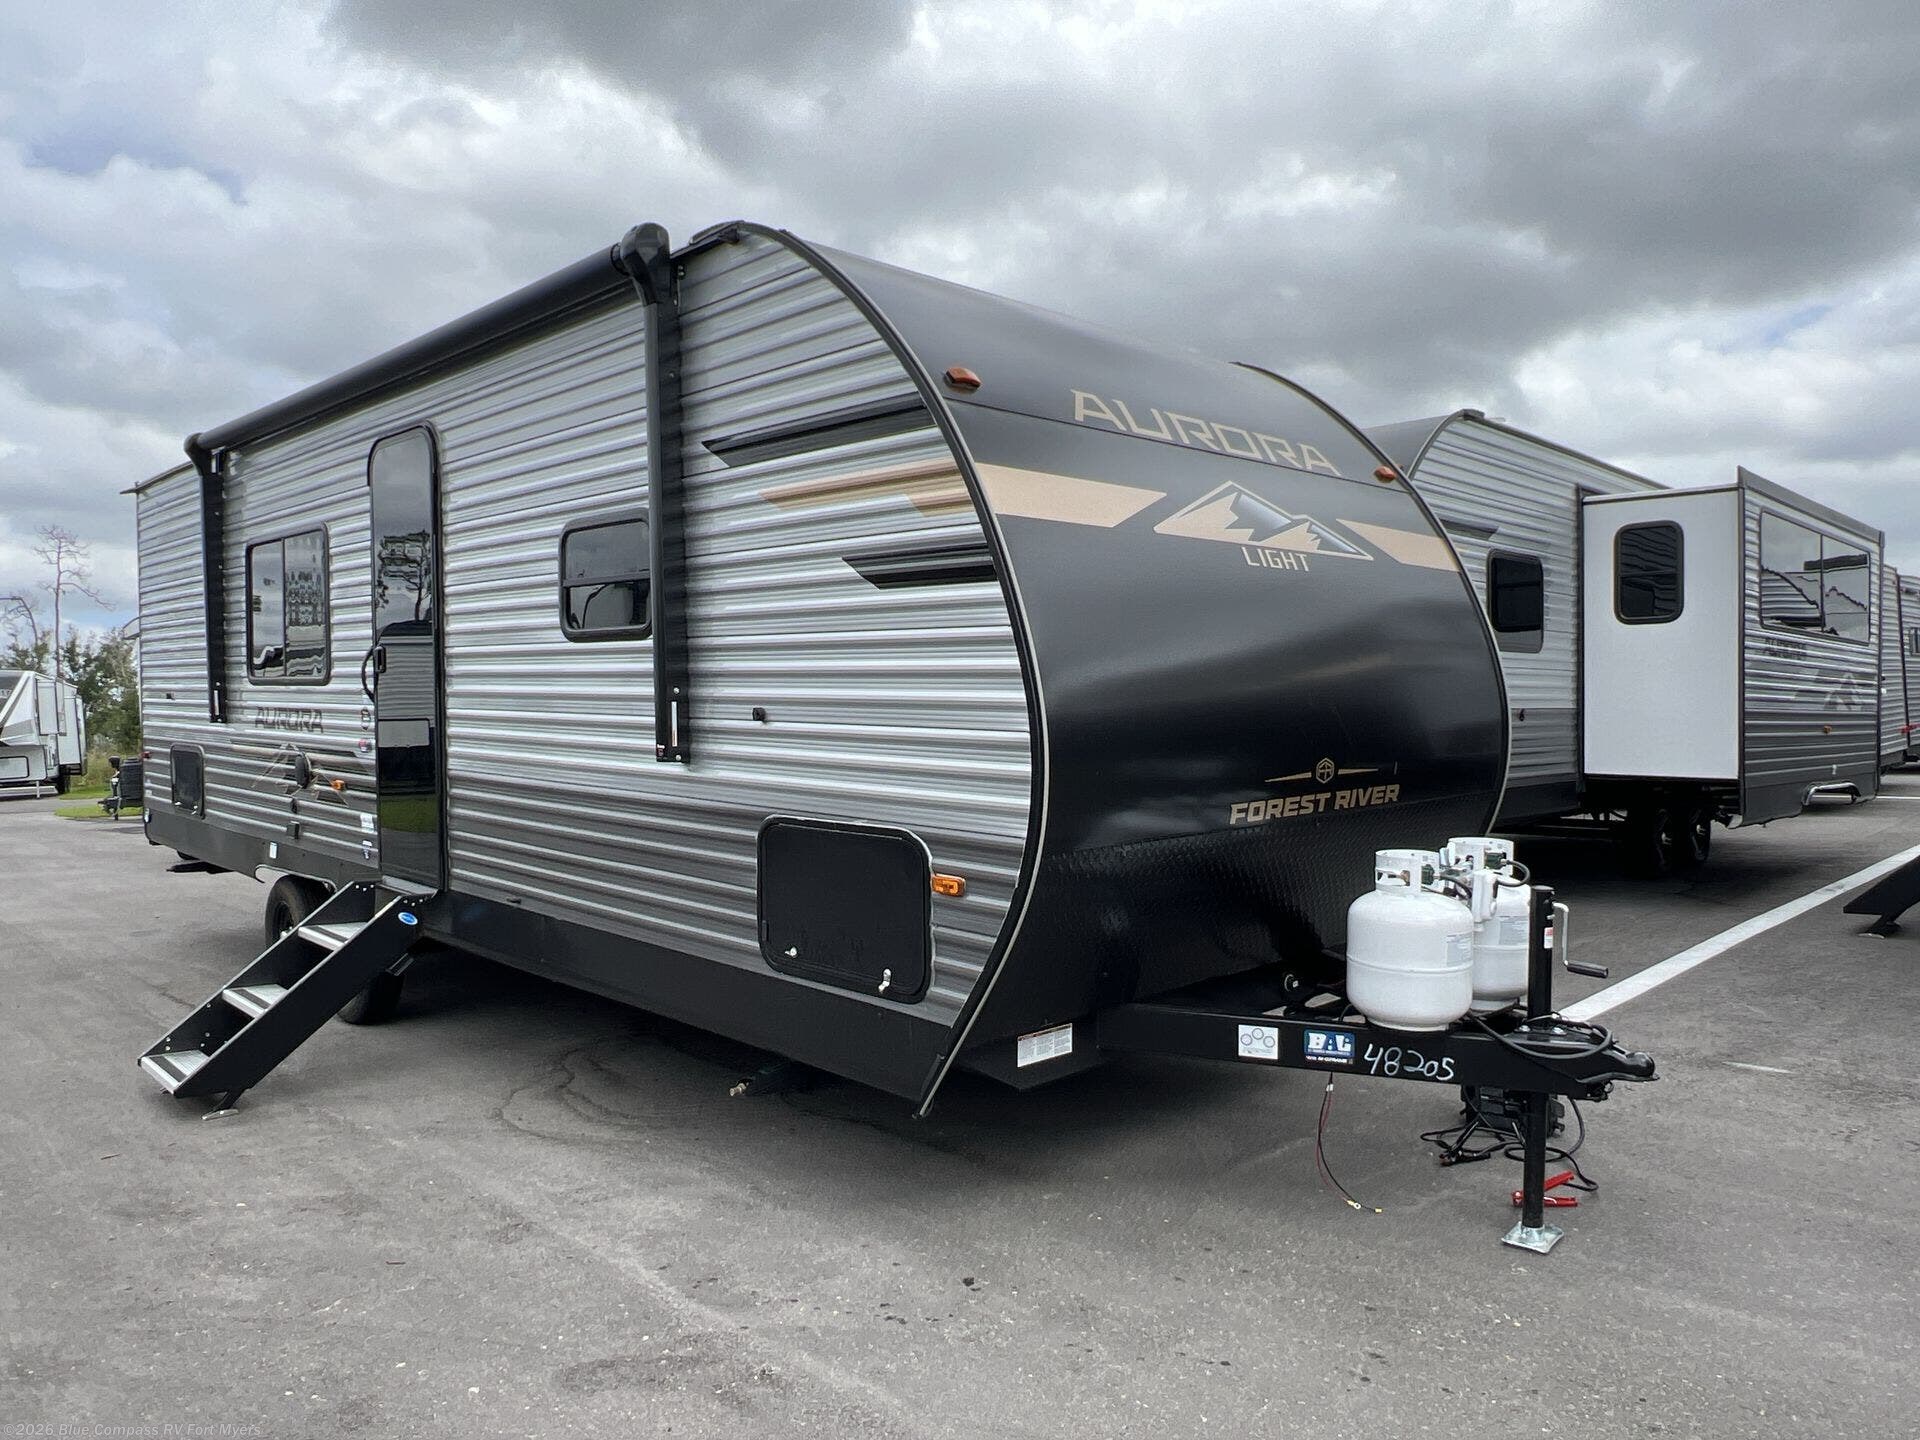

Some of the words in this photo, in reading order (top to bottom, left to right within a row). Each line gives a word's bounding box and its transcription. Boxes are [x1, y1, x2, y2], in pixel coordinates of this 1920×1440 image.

[1070, 389, 1342, 476] AURORA
[1241, 546, 1310, 572] LIGHT
[255, 706, 324, 733] AURORA
[1229, 792, 1331, 825] FOREST
[1334, 783, 1400, 810] RIVER
[1363, 1042, 1456, 1081] 48205
